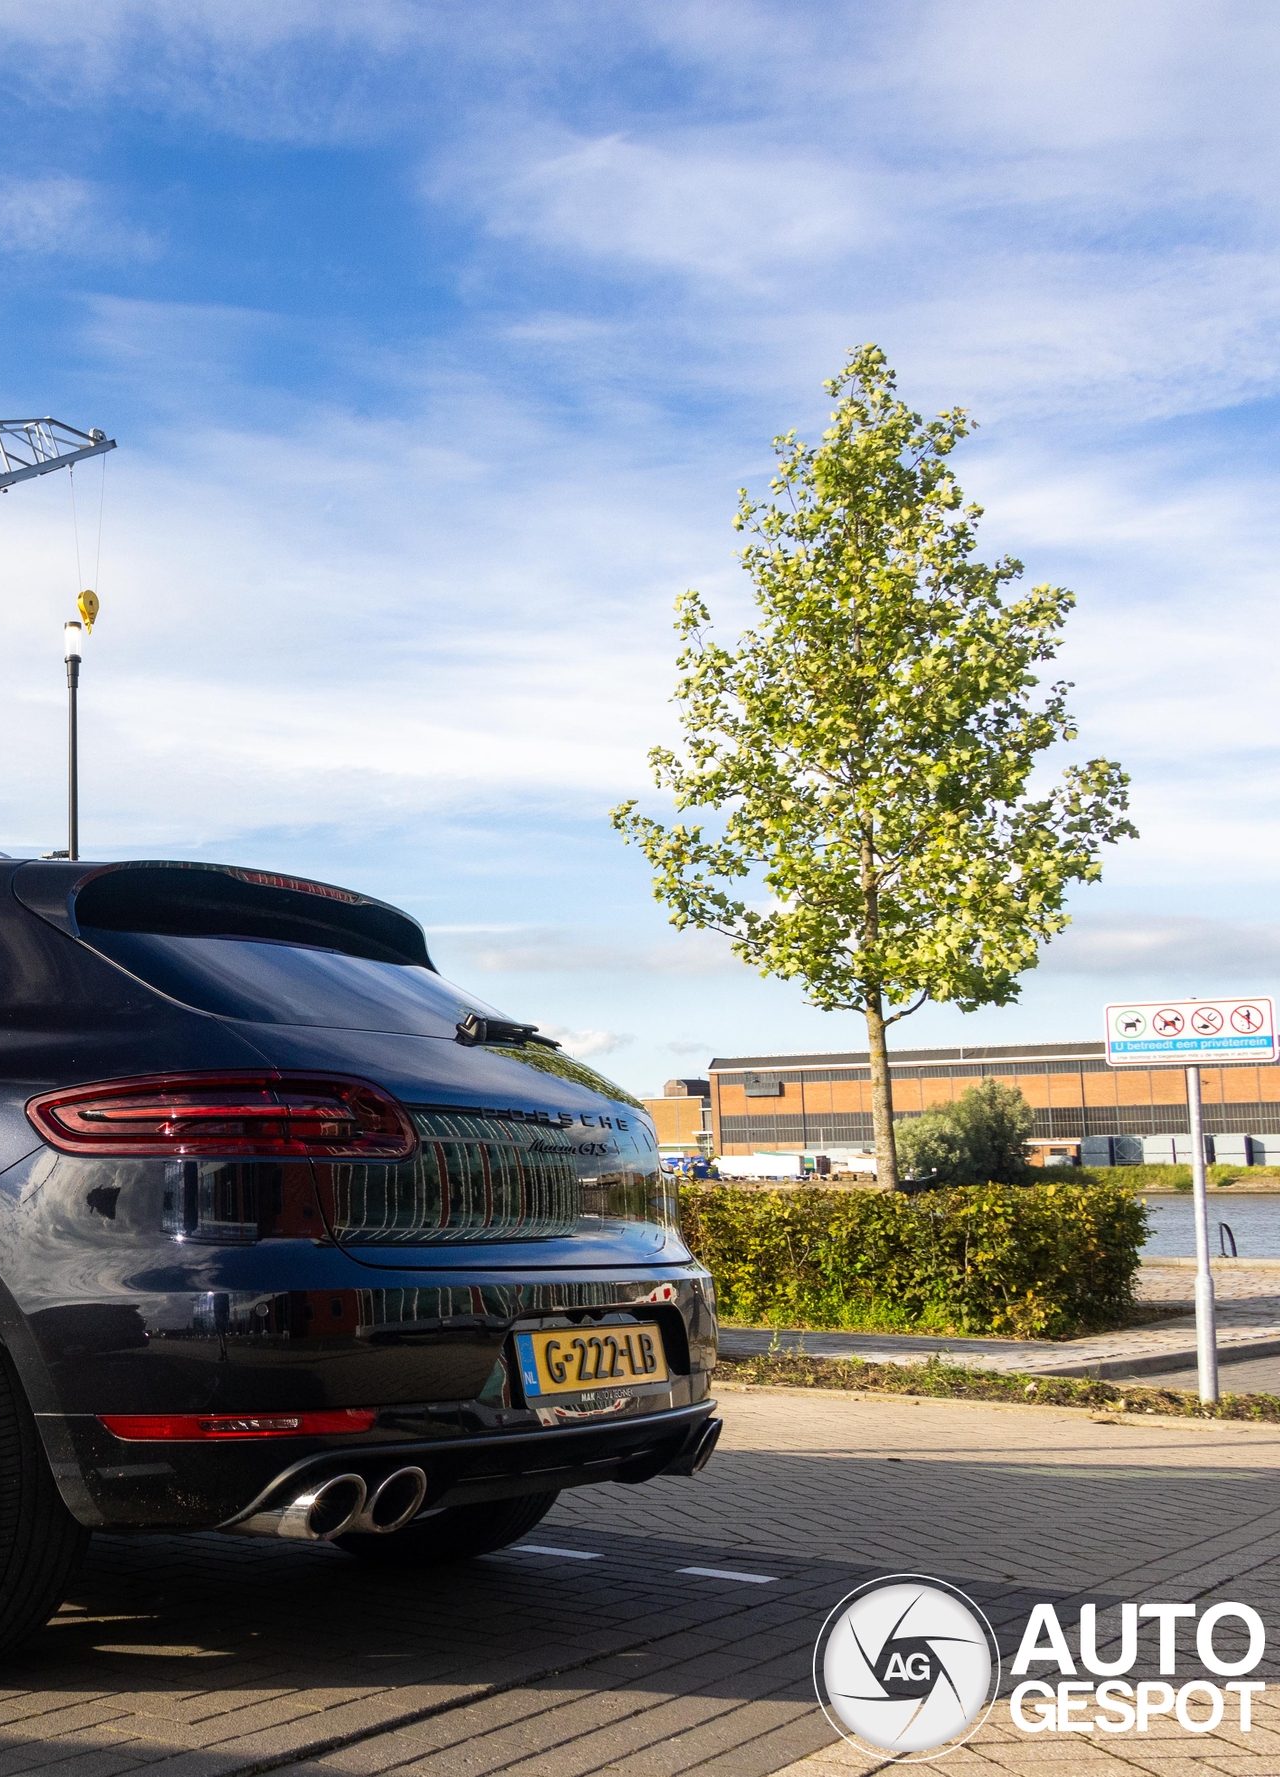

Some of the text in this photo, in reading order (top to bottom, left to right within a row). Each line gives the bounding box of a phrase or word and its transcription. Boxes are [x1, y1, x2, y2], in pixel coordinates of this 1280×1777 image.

[1115, 1036, 1267, 1051] U betreedt een privéterrein
[479, 1106, 630, 1132] PORSCHE
[528, 1138, 608, 1156] Macan GTS
[546, 1333, 657, 1383] G-222-LB
[524, 1371, 537, 1385] NL
[581, 1392, 596, 1402] MAK
